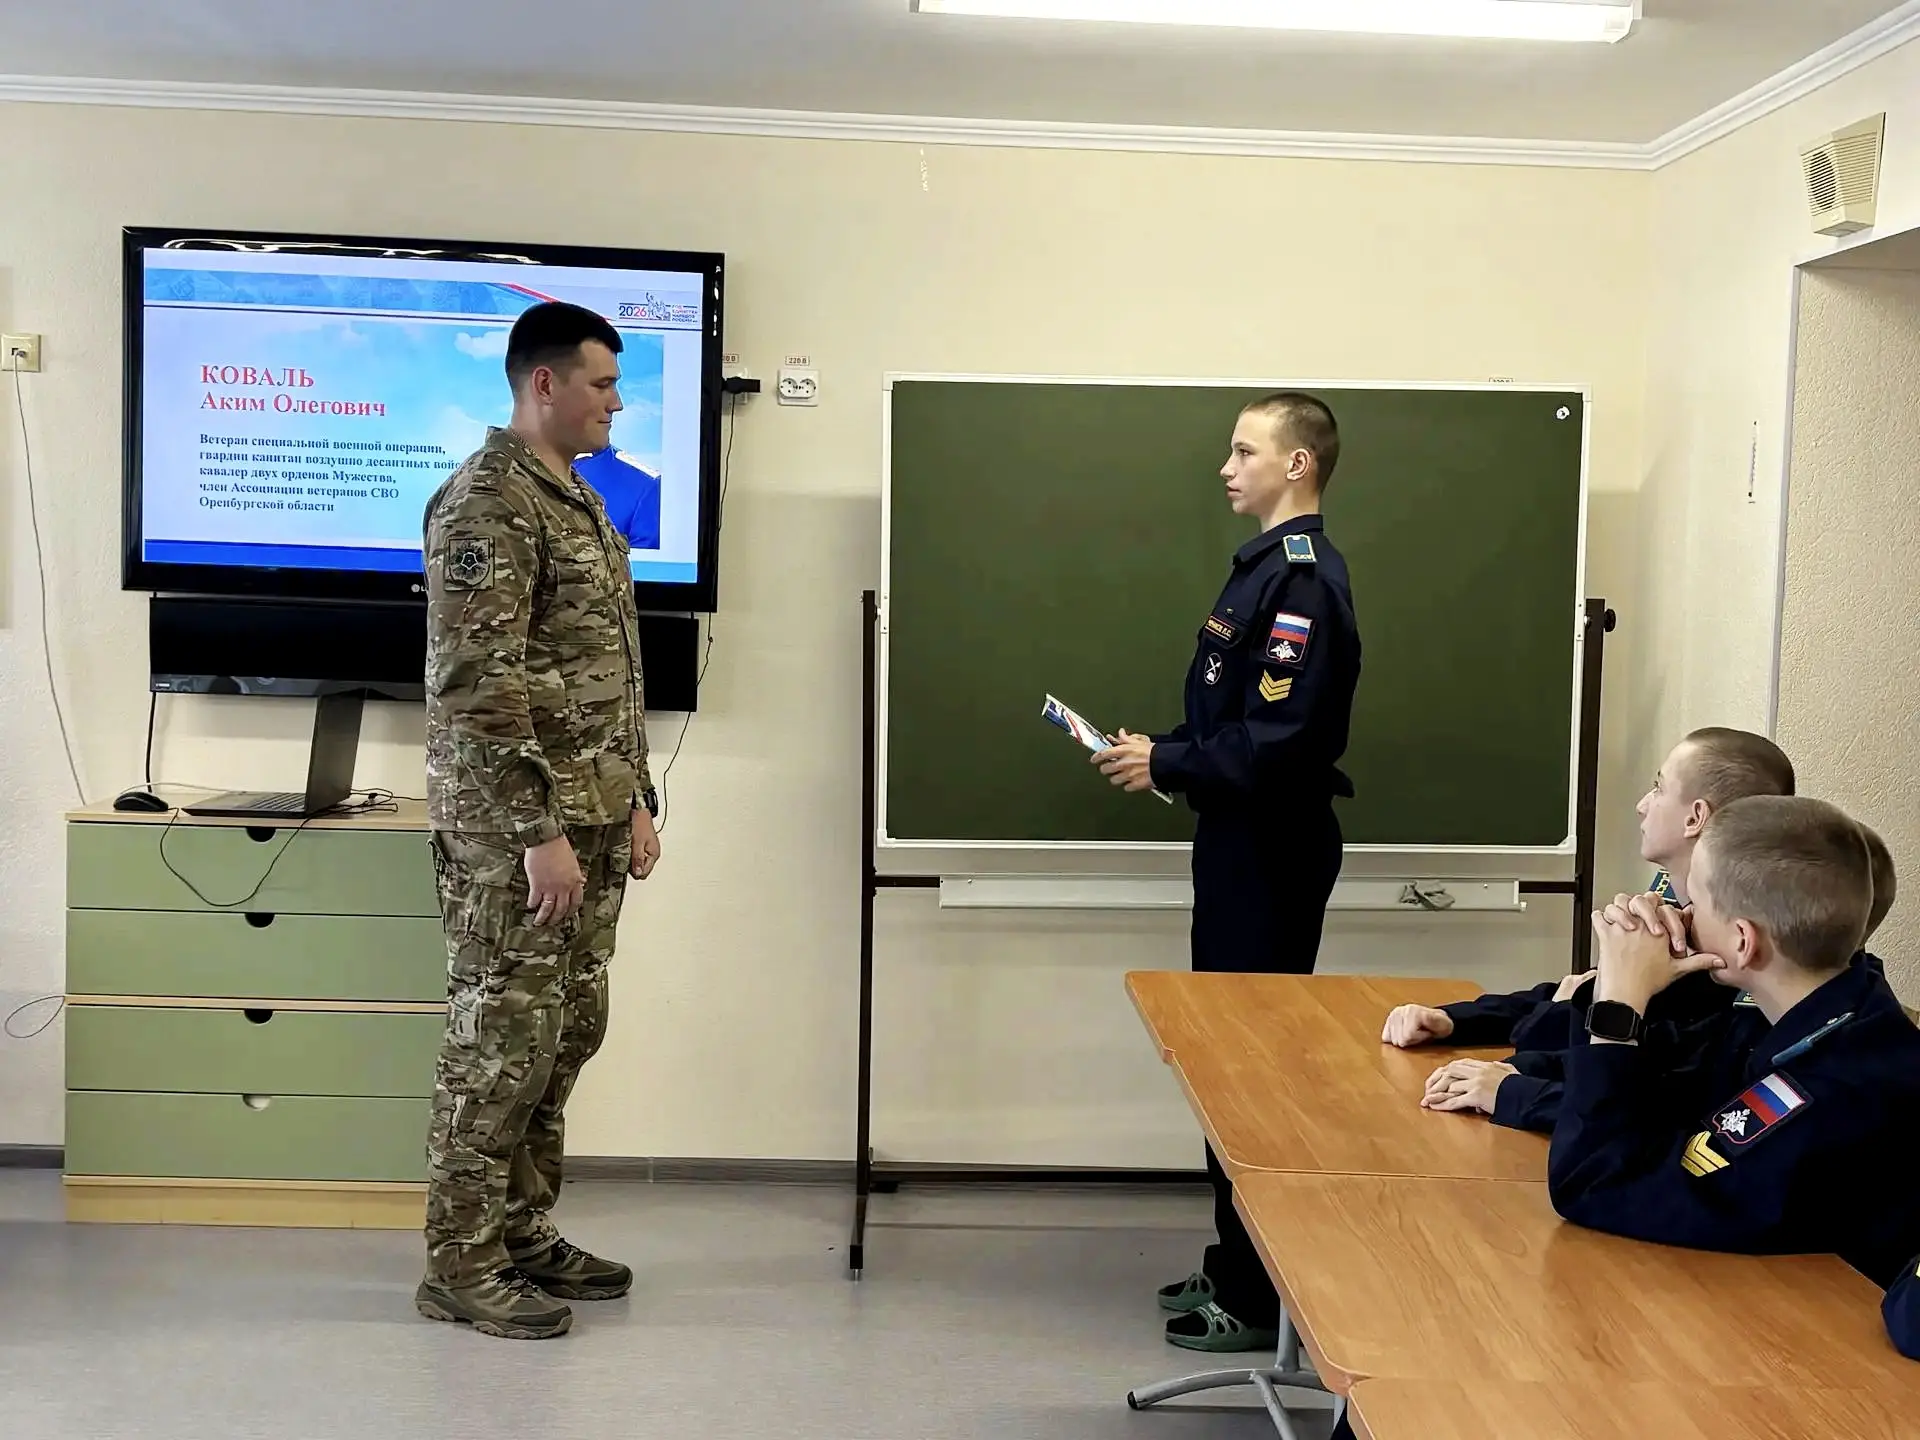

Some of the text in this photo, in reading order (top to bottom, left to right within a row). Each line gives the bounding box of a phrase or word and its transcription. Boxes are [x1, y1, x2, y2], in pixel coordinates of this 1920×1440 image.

[618, 305, 647, 317] 2026
[200, 365, 314, 388] КОВАЛЬ
[200, 391, 386, 417] Аким Олегович
[200, 433, 446, 455] Ветеран специальной военной операции,
[199, 451, 248, 463] гвардии
[252, 454, 301, 464] капитан
[305, 455, 363, 467] воздушно
[366, 458, 430, 469] десантных
[199, 467, 396, 484] кавалер двух орденов Мужества,
[199, 482, 399, 499] член Ассоциации ветеранов СВО
[199, 496, 334, 512] Оренбургской области
